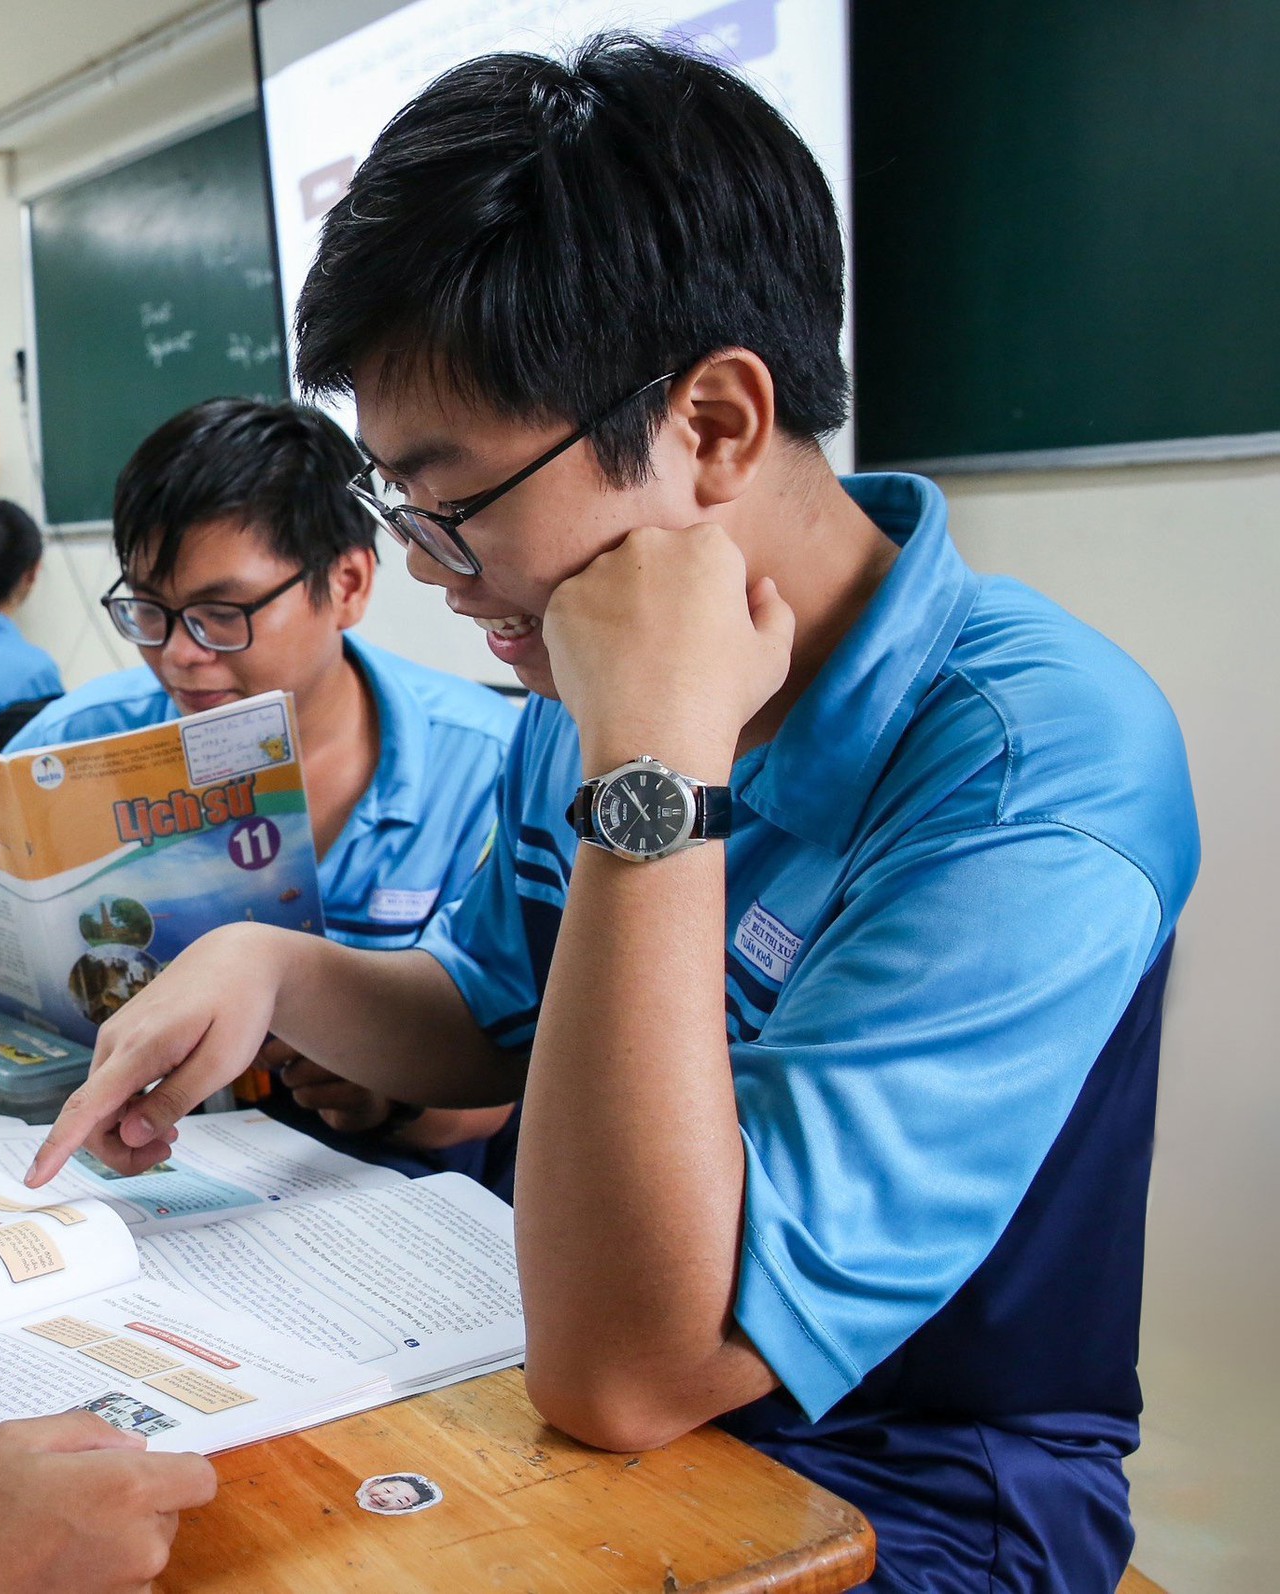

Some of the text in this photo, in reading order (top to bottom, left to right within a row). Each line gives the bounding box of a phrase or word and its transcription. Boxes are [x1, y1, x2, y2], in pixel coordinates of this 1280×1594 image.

[113, 789, 203, 847] Lịch
[231, 820, 275, 867] 11
[751, 921, 765, 938] BÙI
[764, 932, 778, 950] THỊ
[766, 920, 778, 933] TRUNG
[756, 948, 773, 969] KHÔI
[44, 1250, 54, 1266] động
